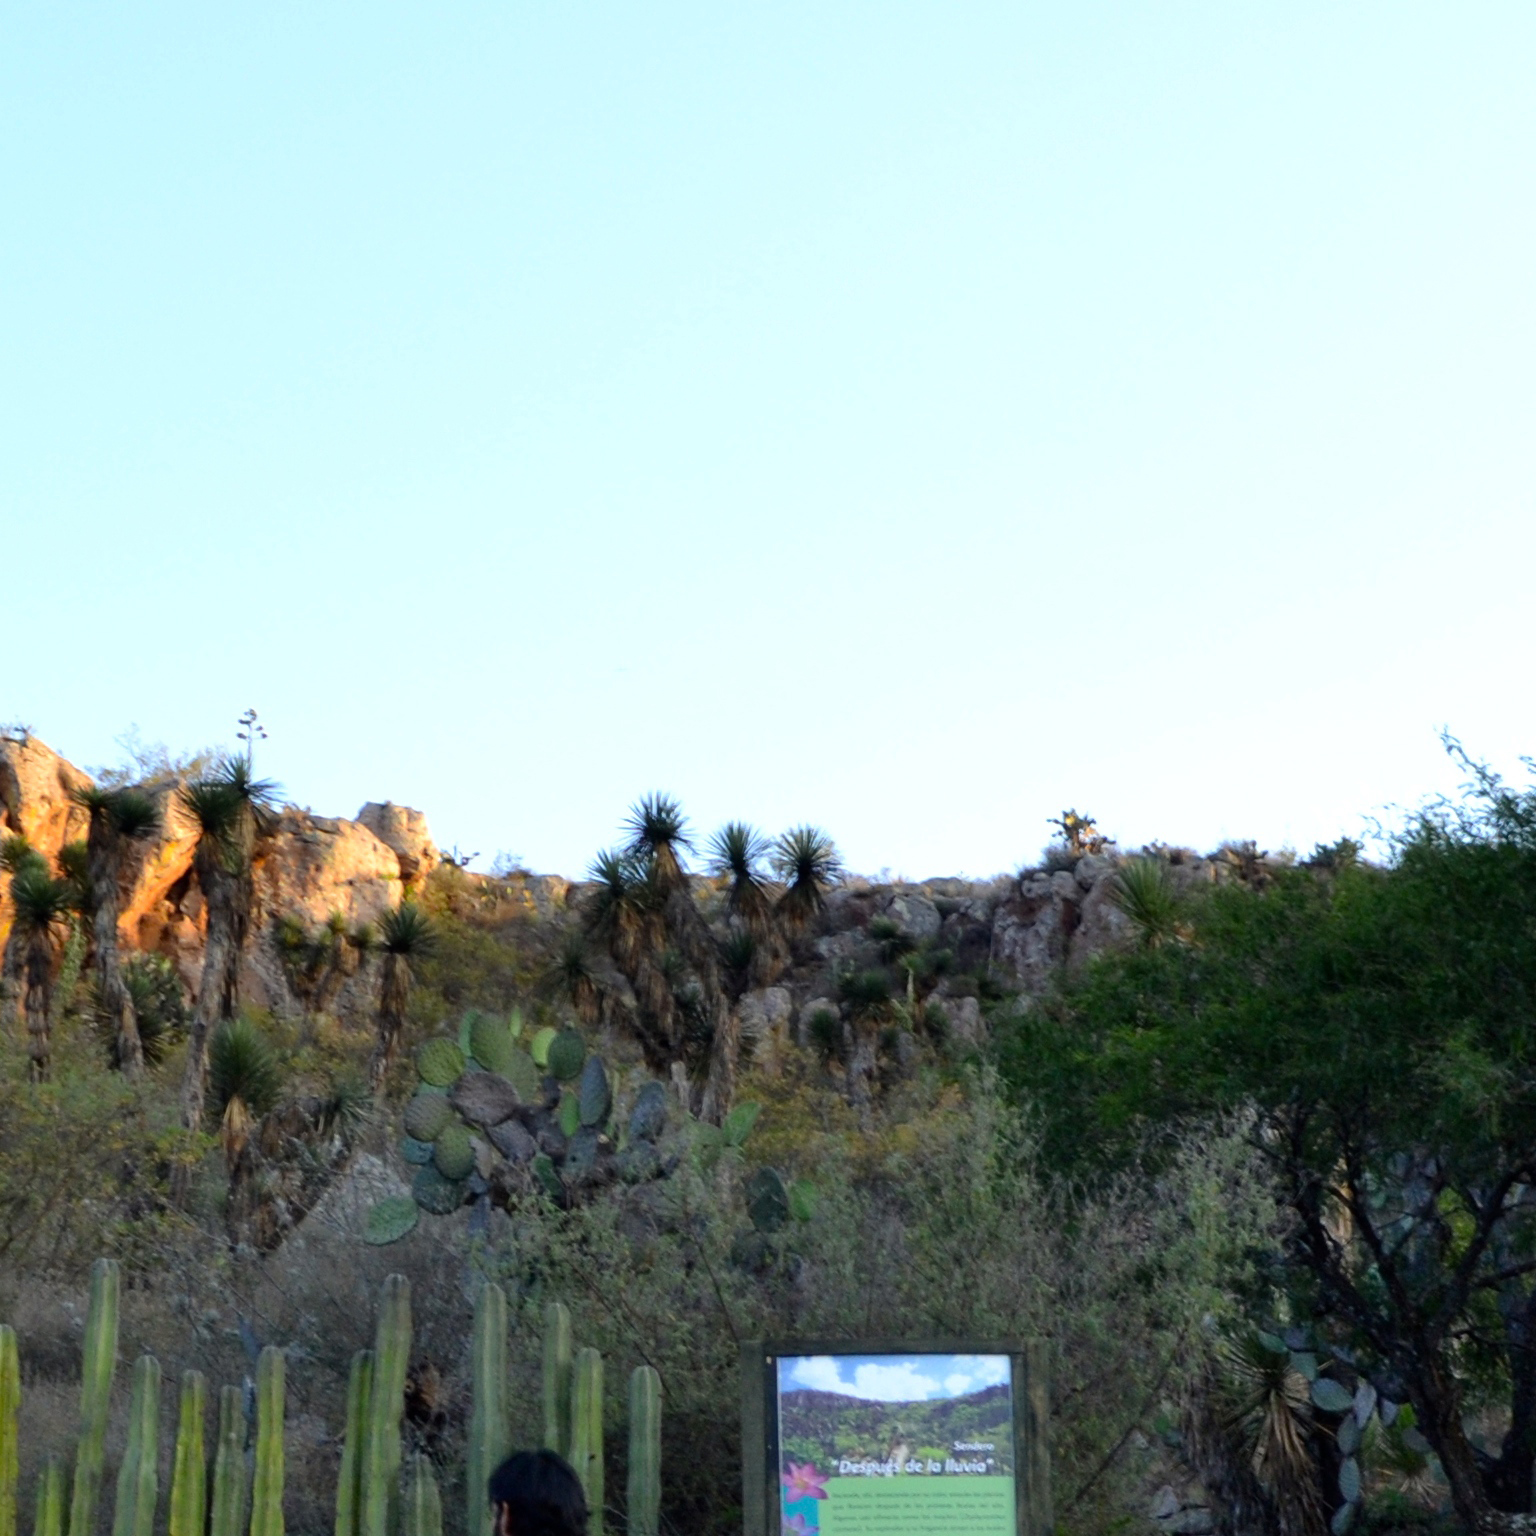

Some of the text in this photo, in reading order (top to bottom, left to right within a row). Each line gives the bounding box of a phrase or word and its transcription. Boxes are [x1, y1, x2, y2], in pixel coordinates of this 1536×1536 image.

[953, 1440, 995, 1451] Sendero
[905, 1458, 924, 1473] de
[927, 1458, 942, 1473] la
